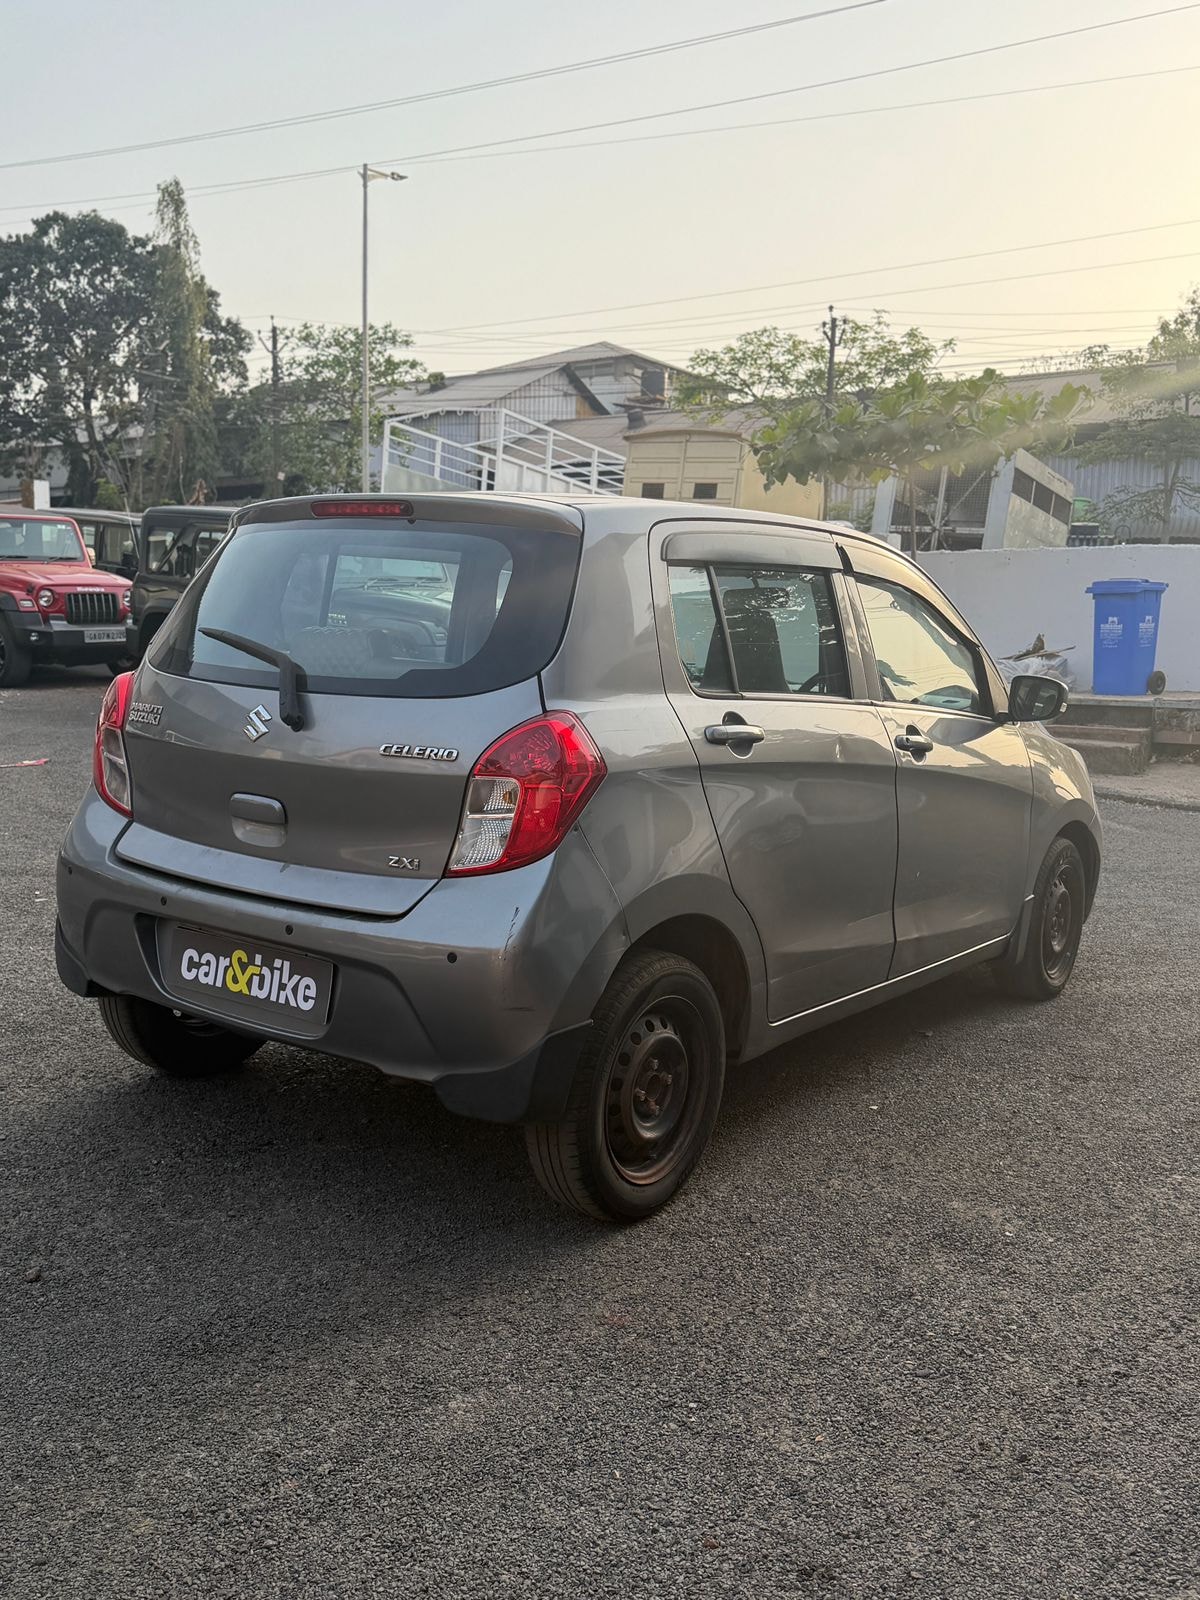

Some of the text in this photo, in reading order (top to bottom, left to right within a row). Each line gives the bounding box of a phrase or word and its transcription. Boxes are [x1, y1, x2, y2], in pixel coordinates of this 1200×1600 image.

[130, 702, 163, 714] MARUTI
[128, 710, 161, 725] SUZUKI
[379, 743, 459, 761] CELERIO
[180, 948, 317, 1011] car&bike
